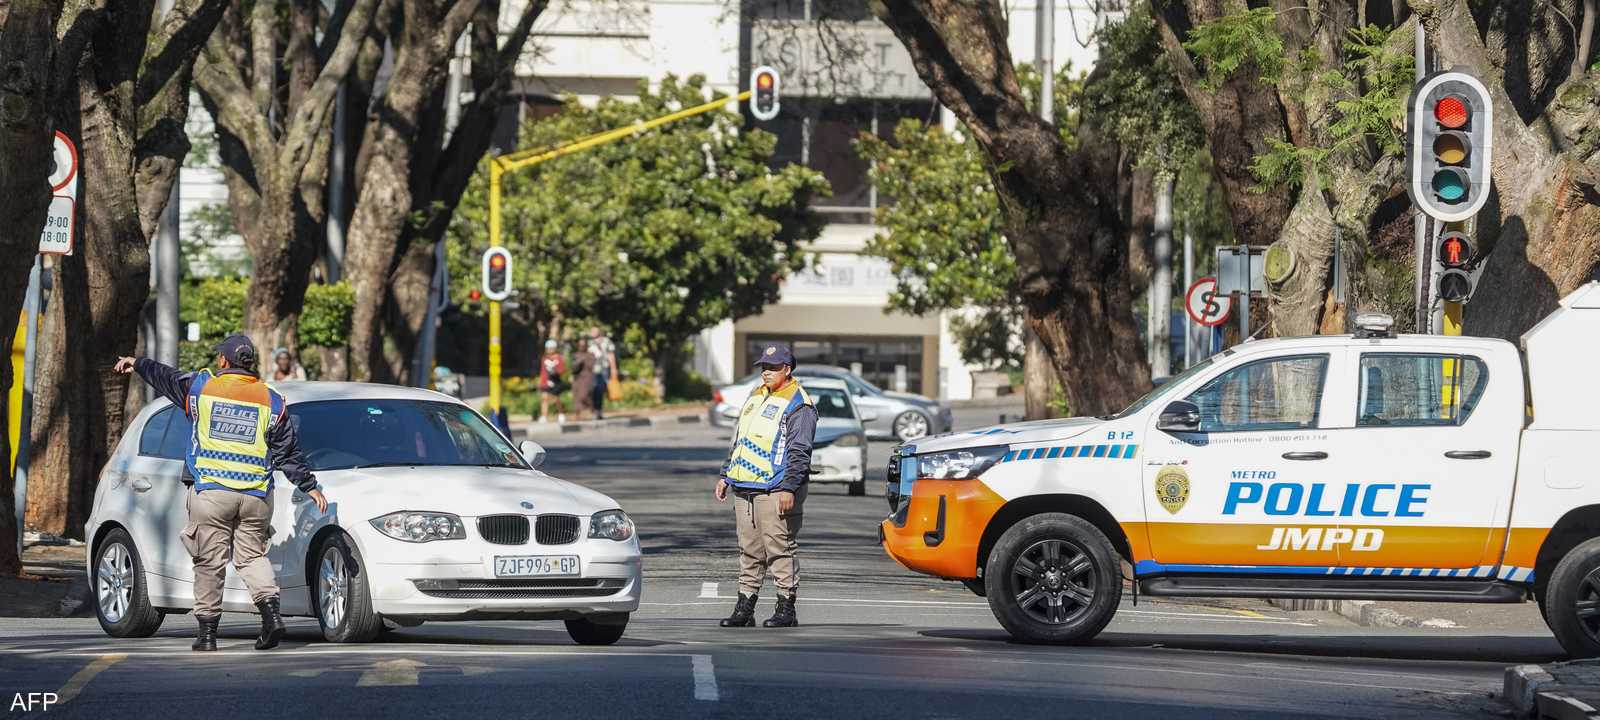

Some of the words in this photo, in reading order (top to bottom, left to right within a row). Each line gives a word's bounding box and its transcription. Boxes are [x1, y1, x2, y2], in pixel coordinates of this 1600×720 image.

[42, 231, 67, 243] 18:00
[213, 405, 258, 420] POLICE
[1107, 431, 1116, 440] B
[1120, 431, 1134, 440] 12
[1233, 436, 1262, 444] Hotline
[1231, 470, 1277, 479] METRO
[1222, 482, 1431, 517] POLICE
[1256, 527, 1385, 551] JMPD
[499, 558, 551, 575] ZJF996
[560, 557, 576, 573] GP
